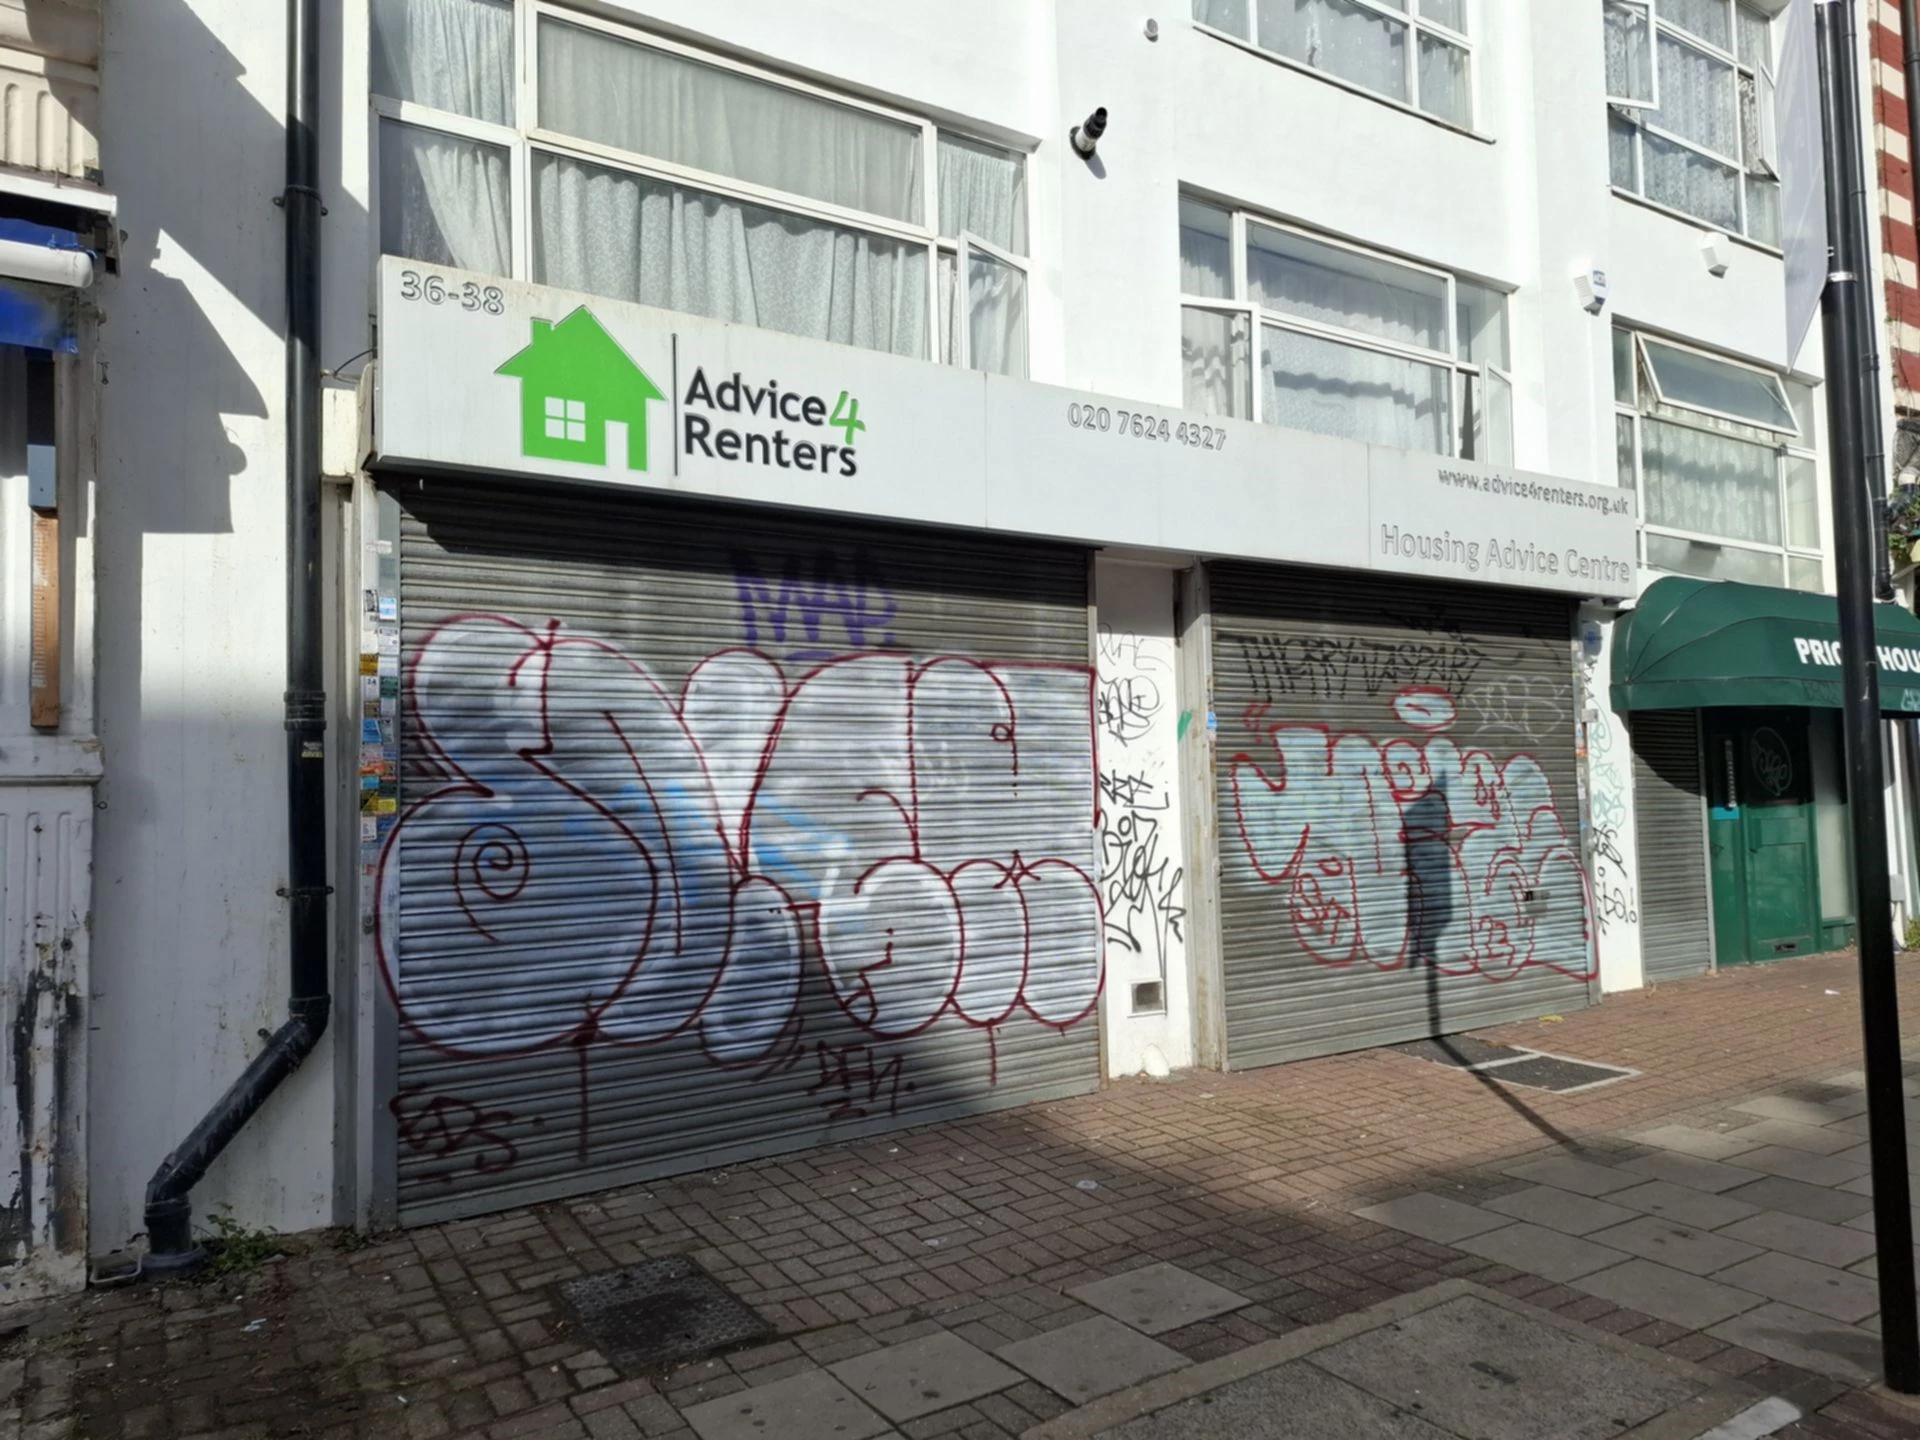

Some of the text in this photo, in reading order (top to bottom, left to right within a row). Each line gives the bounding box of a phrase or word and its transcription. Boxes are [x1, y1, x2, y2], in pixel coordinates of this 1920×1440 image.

[400, 270, 505, 316] 36-38
[684, 412, 858, 478] Renters
[1067, 402, 1227, 451] 020 7624 4327
[1437, 469, 1629, 515] www.advice4renters.org.uk
[1381, 523, 1631, 583] Housing Advice Centre
[1793, 637, 1920, 674] PRIC HOU
